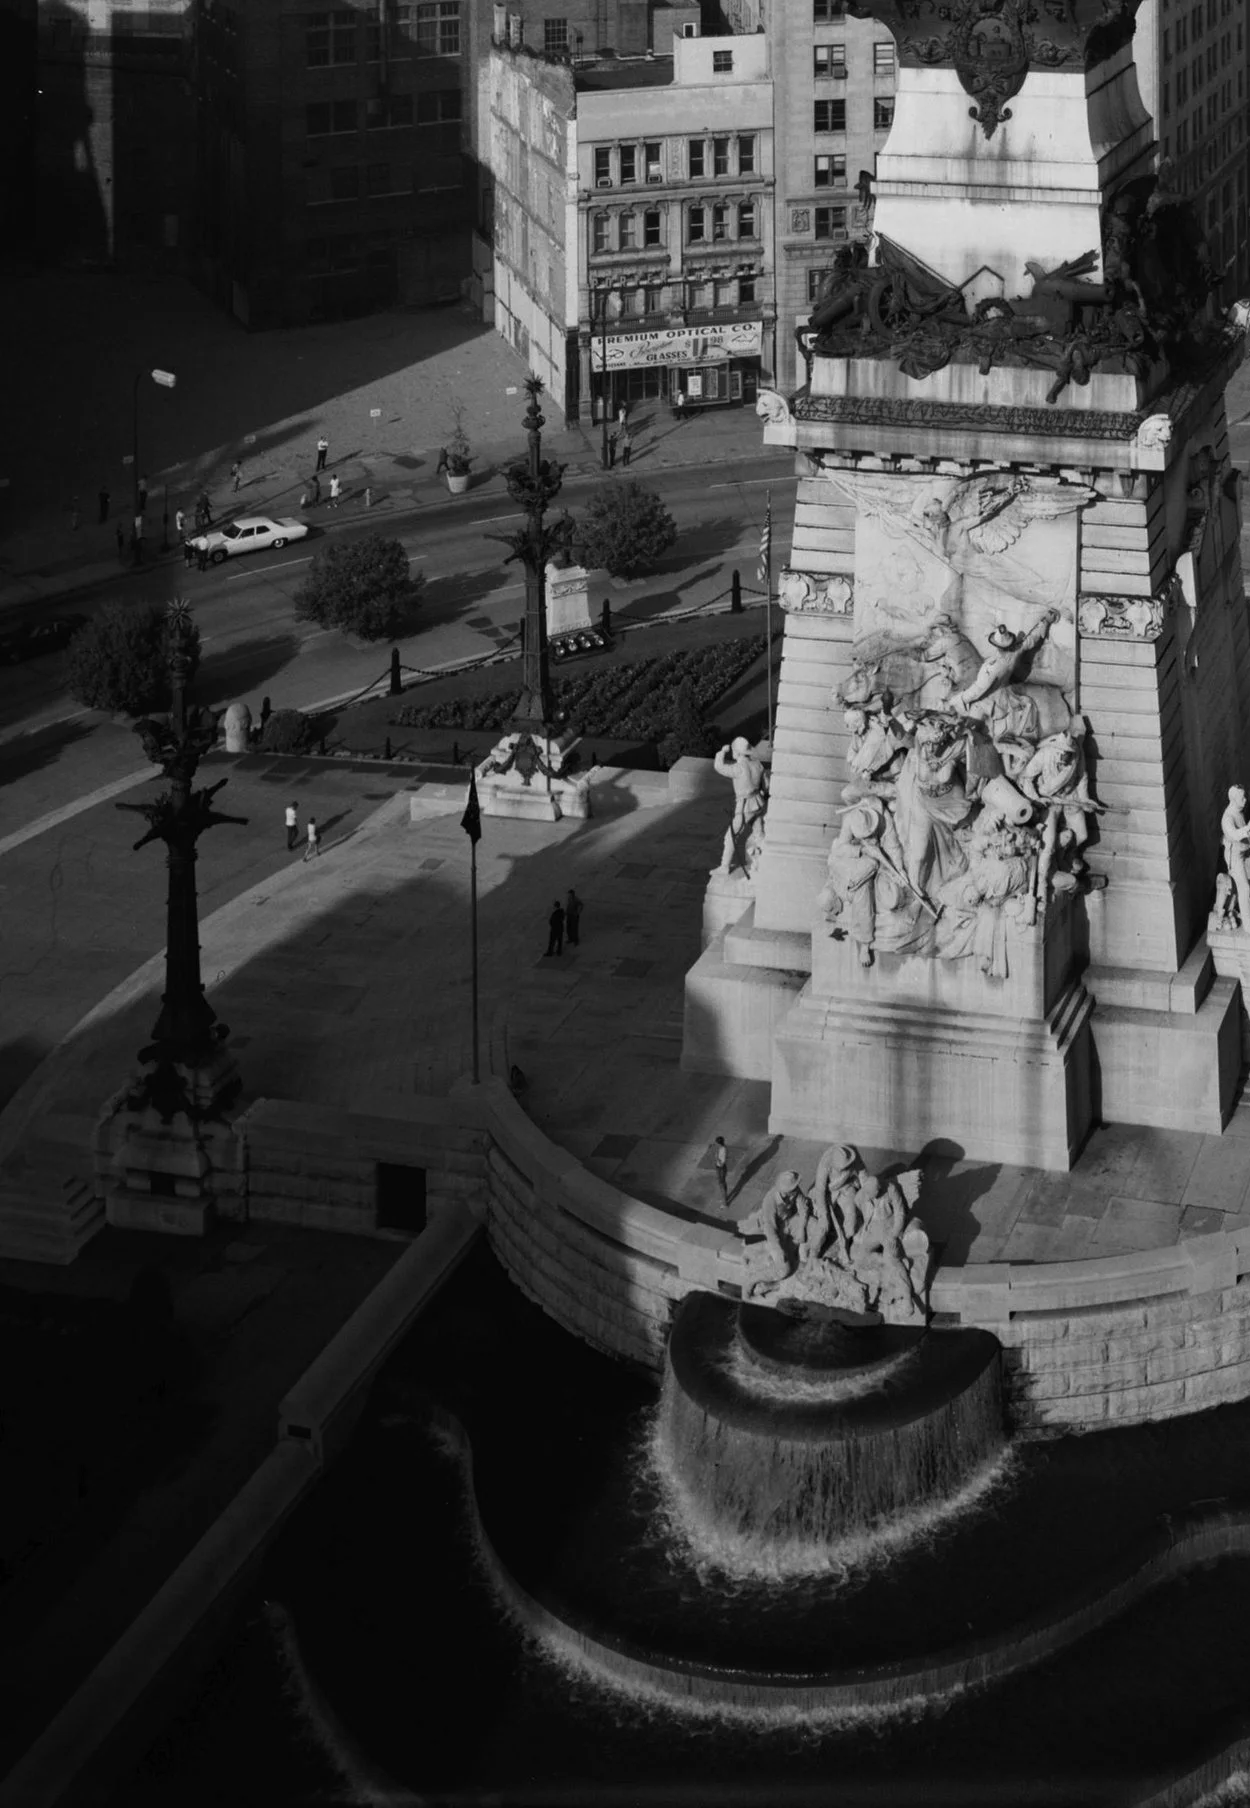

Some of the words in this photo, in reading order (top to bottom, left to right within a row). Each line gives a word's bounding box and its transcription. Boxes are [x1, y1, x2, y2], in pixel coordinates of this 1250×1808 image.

[666, 326, 727, 339] OPTICAL
[731, 323, 757, 333] CO.
[646, 350, 688, 362] GLASSES
